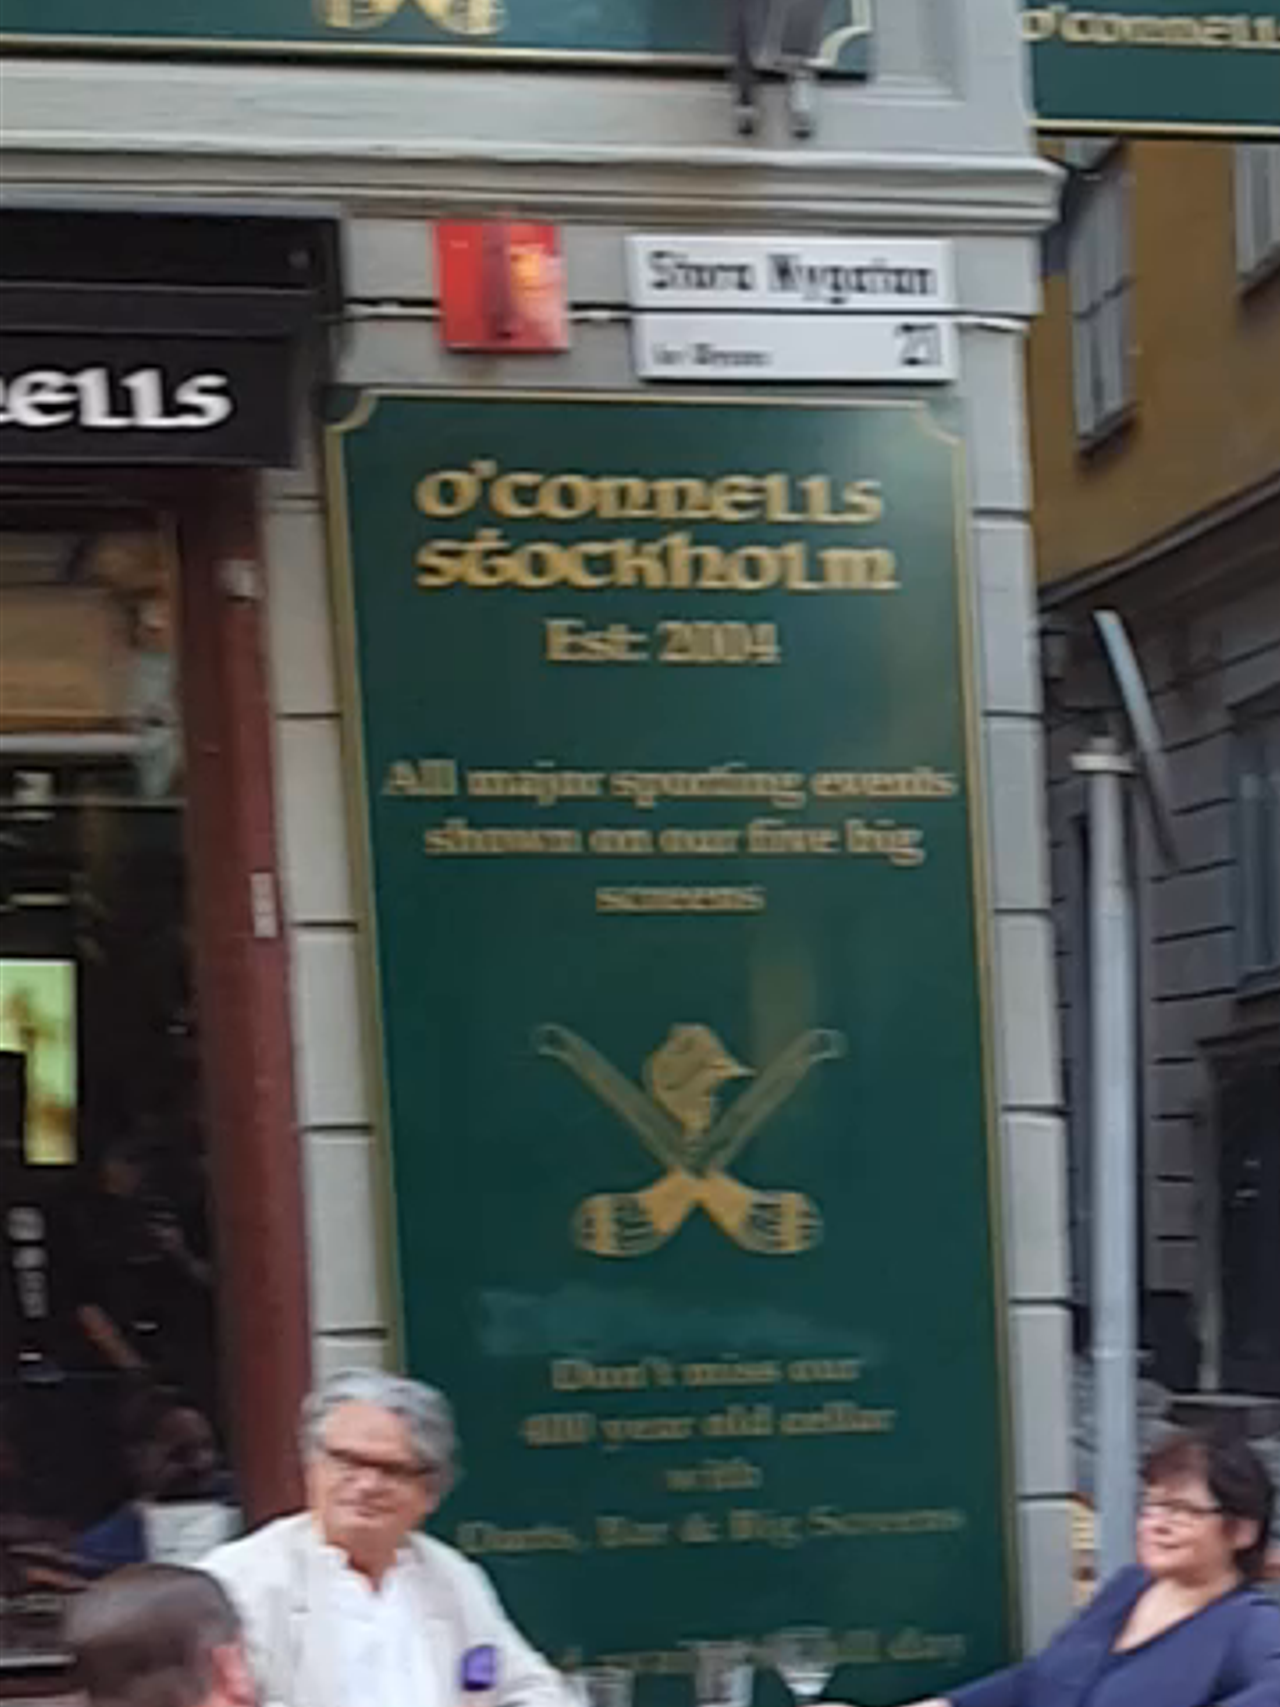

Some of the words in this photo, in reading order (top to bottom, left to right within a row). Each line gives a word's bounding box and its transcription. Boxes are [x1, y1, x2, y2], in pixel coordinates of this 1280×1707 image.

[649, 250, 756, 292] Stora
[767, 253, 940, 306] Nygatan
[384, 759, 458, 796] All
[466, 760, 603, 807] major
[609, 762, 806, 810] sporting
[811, 766, 960, 798] events
[424, 817, 584, 854] shown
[587, 827, 655, 854] on
[658, 828, 742, 855] our
[747, 817, 840, 855] five
[845, 817, 926, 866] big
[550, 1354, 677, 1392] Don't
[682, 1352, 783, 1387] miss
[785, 1357, 863, 1384] our
[701, 1402, 776, 1438] old
